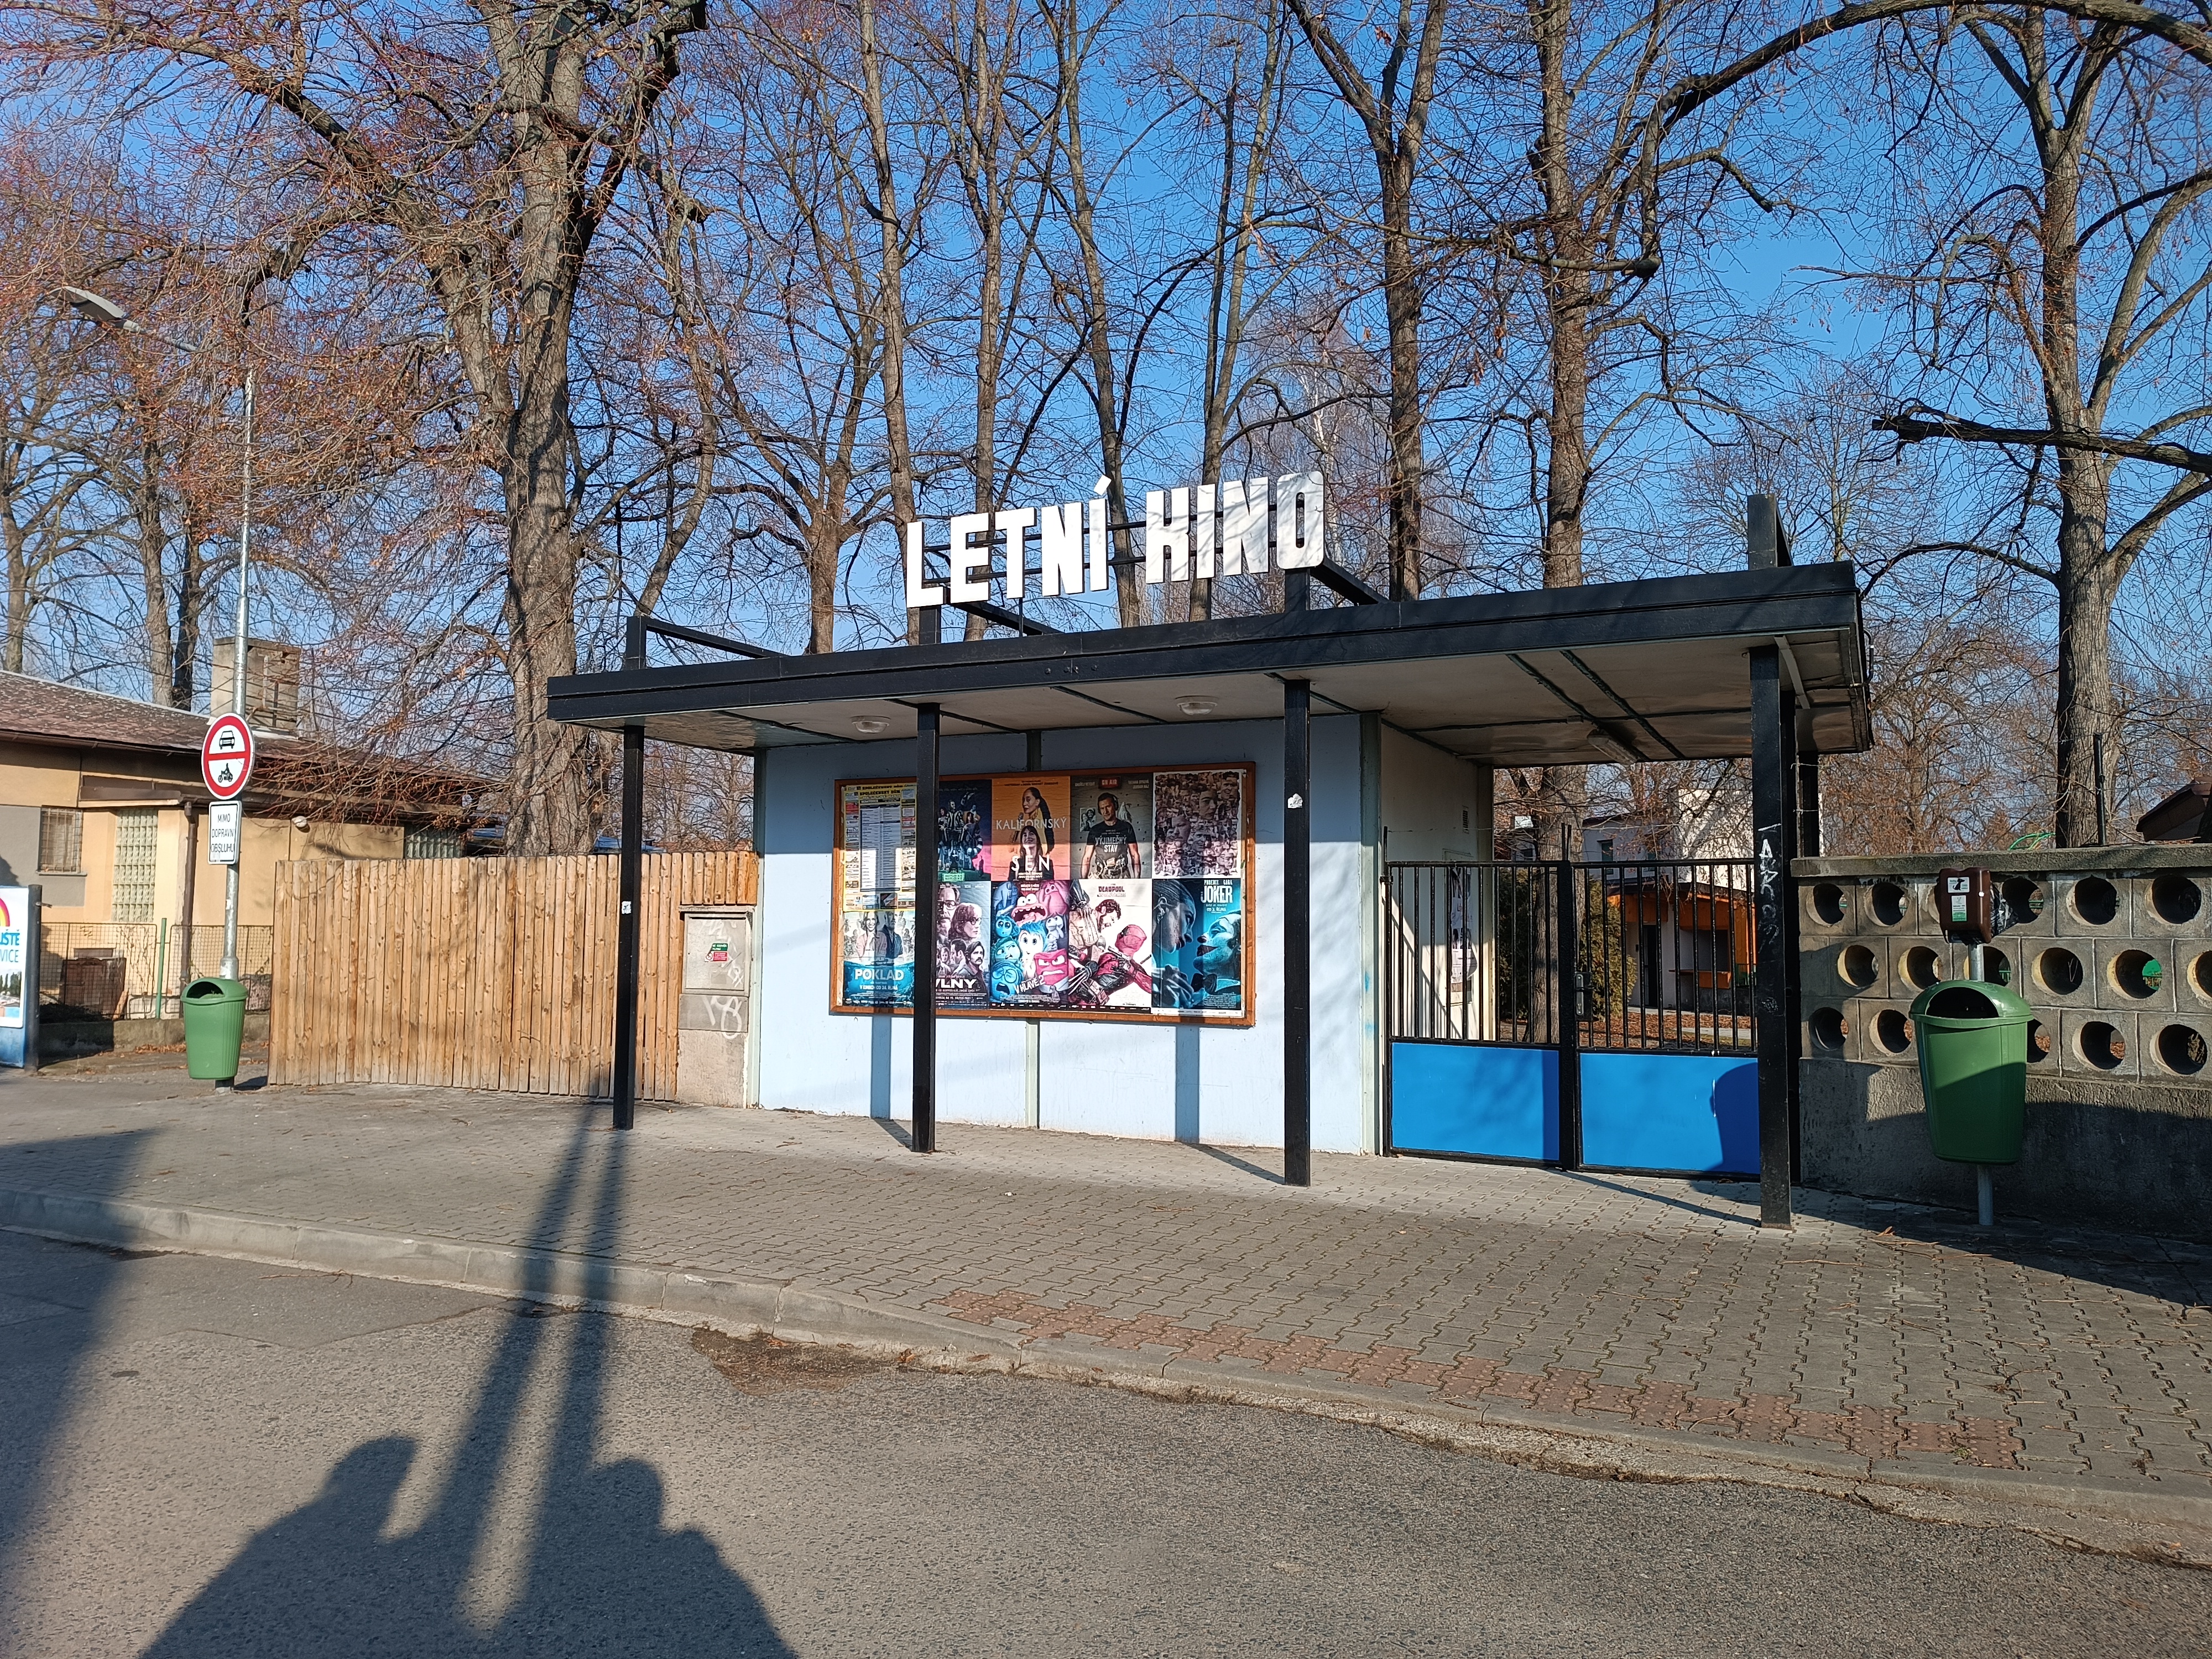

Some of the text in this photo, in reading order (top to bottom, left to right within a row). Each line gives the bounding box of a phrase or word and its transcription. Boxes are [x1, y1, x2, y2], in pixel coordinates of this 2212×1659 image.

[906, 471, 1325, 608] LETNÍ KINO
[217, 813, 231, 823] MIMO
[996, 817, 1067, 830] KALIFORNSKÝ
[1095, 835, 1126, 845] VÝJIMEČNÝ
[211, 843, 234, 853] OBSLUHU
[1011, 854, 1050, 872] SEN
[1201, 885, 1233, 903] JOKER
[0, 929, 20, 946] IŠTĚ
[855, 968, 904, 980] POKLAD
[1013, 975, 1046, 994] V HLAVĚ 2
